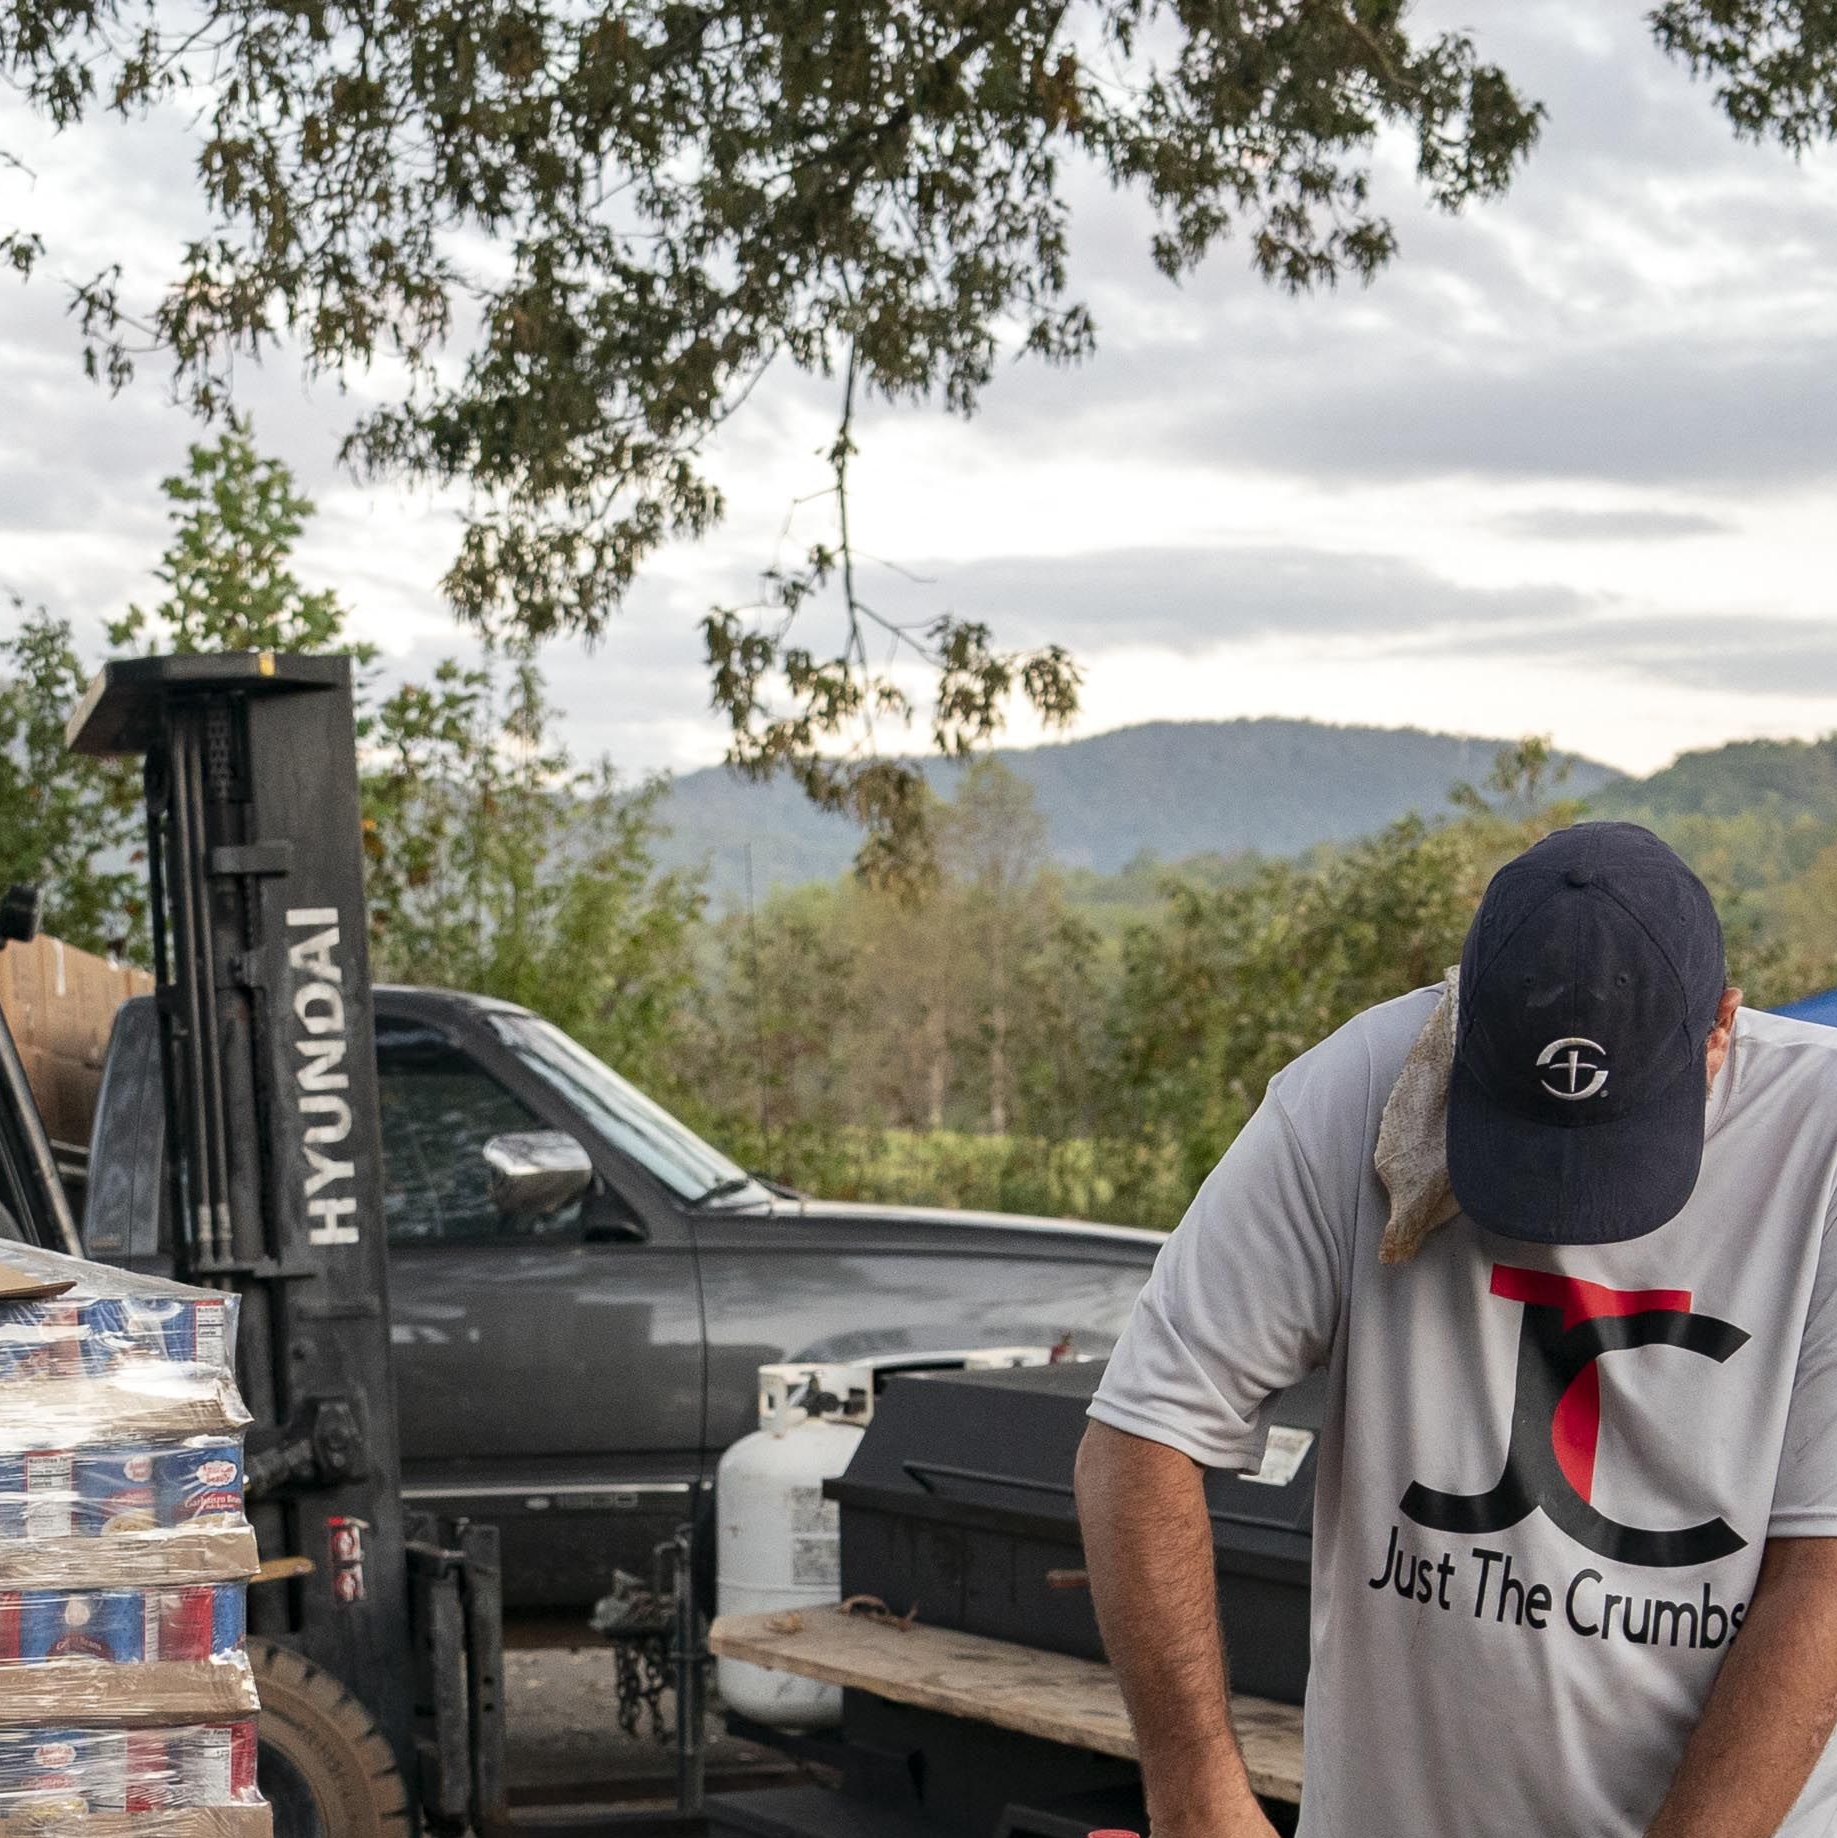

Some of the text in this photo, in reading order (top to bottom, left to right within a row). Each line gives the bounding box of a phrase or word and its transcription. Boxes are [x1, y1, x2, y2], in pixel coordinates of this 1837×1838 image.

[286, 907, 359, 1246] HYUNDAI
[1369, 1526, 1745, 1650] Just The Crumbs
